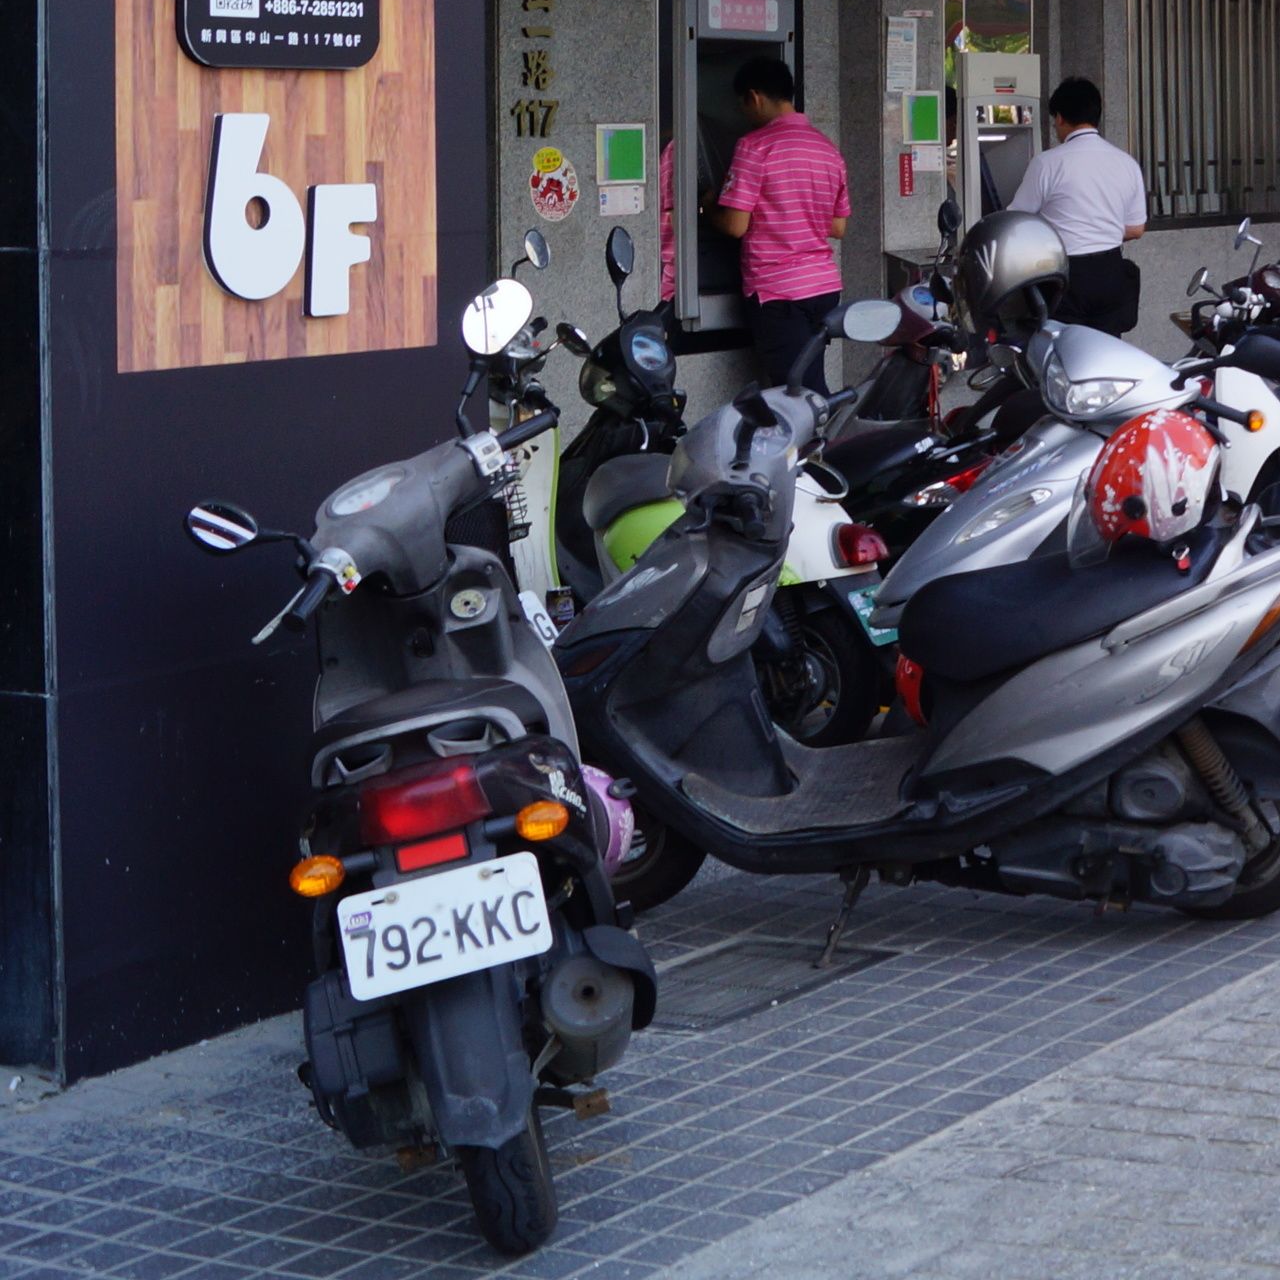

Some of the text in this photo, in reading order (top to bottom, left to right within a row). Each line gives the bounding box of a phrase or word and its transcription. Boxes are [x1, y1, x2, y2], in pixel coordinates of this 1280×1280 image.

[265, 0, 364, 18] +886-7-2851231
[510, 98, 560, 139] 117
[202, 112, 378, 317] 6F
[349, 889, 541, 979] 792-KKC
